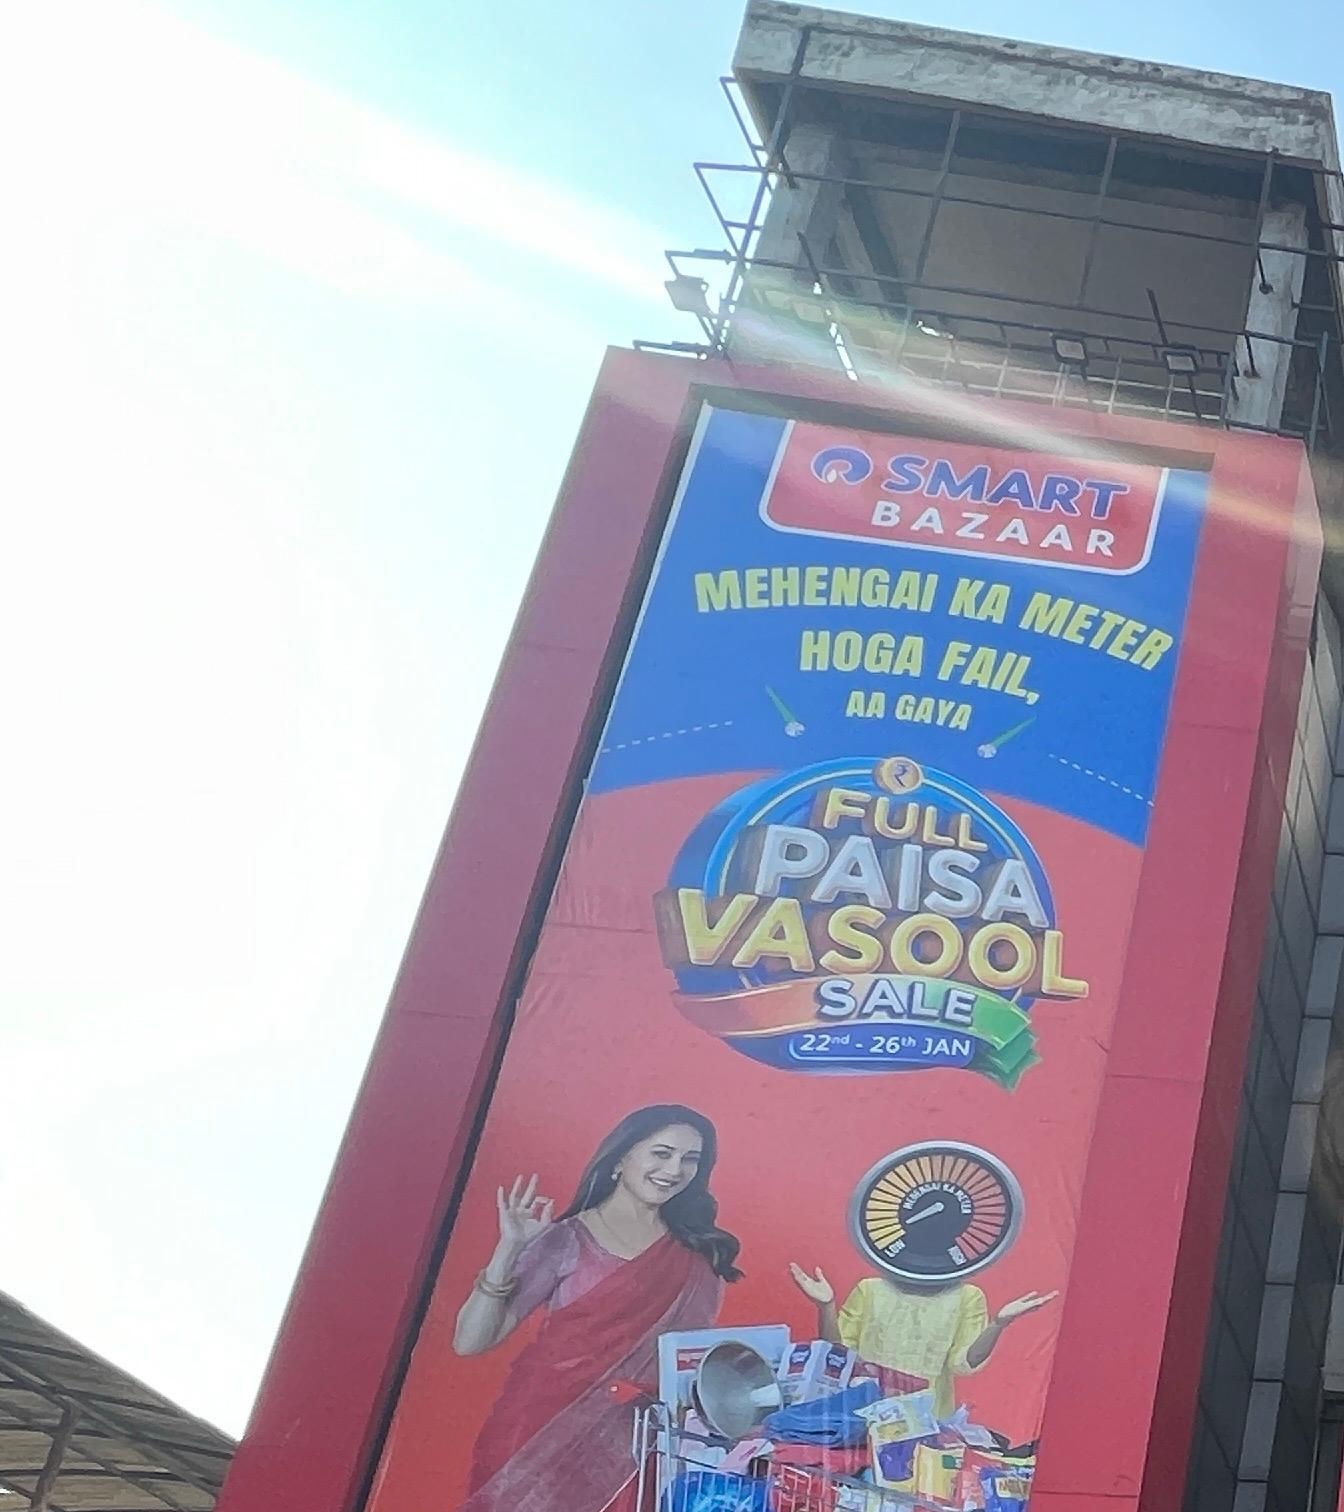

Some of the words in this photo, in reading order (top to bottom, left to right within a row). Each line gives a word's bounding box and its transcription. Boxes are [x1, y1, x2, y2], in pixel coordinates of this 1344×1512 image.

[881, 451, 1131, 521] SMART
[871, 501, 1116, 557] BAZAAR
[695, 567, 936, 613] MEHENGAI
[948, 577, 1008, 624] KA
[1019, 589, 1175, 672] METER
[800, 629, 923, 678] HOGA
[938, 641, 1041, 706] FAIL,
[846, 690, 886, 719] AA
[894, 694, 973, 731] GAYA
[822, 786, 988, 851] FULL
[755, 823, 1051, 927] PAISA
[677, 888, 1090, 998] VASOOL
[818, 978, 976, 1025] SALE
[799, 1034, 850, 1051] 22nd
[869, 1036, 917, 1054] 26th
[922, 1037, 971, 1056] JAN
